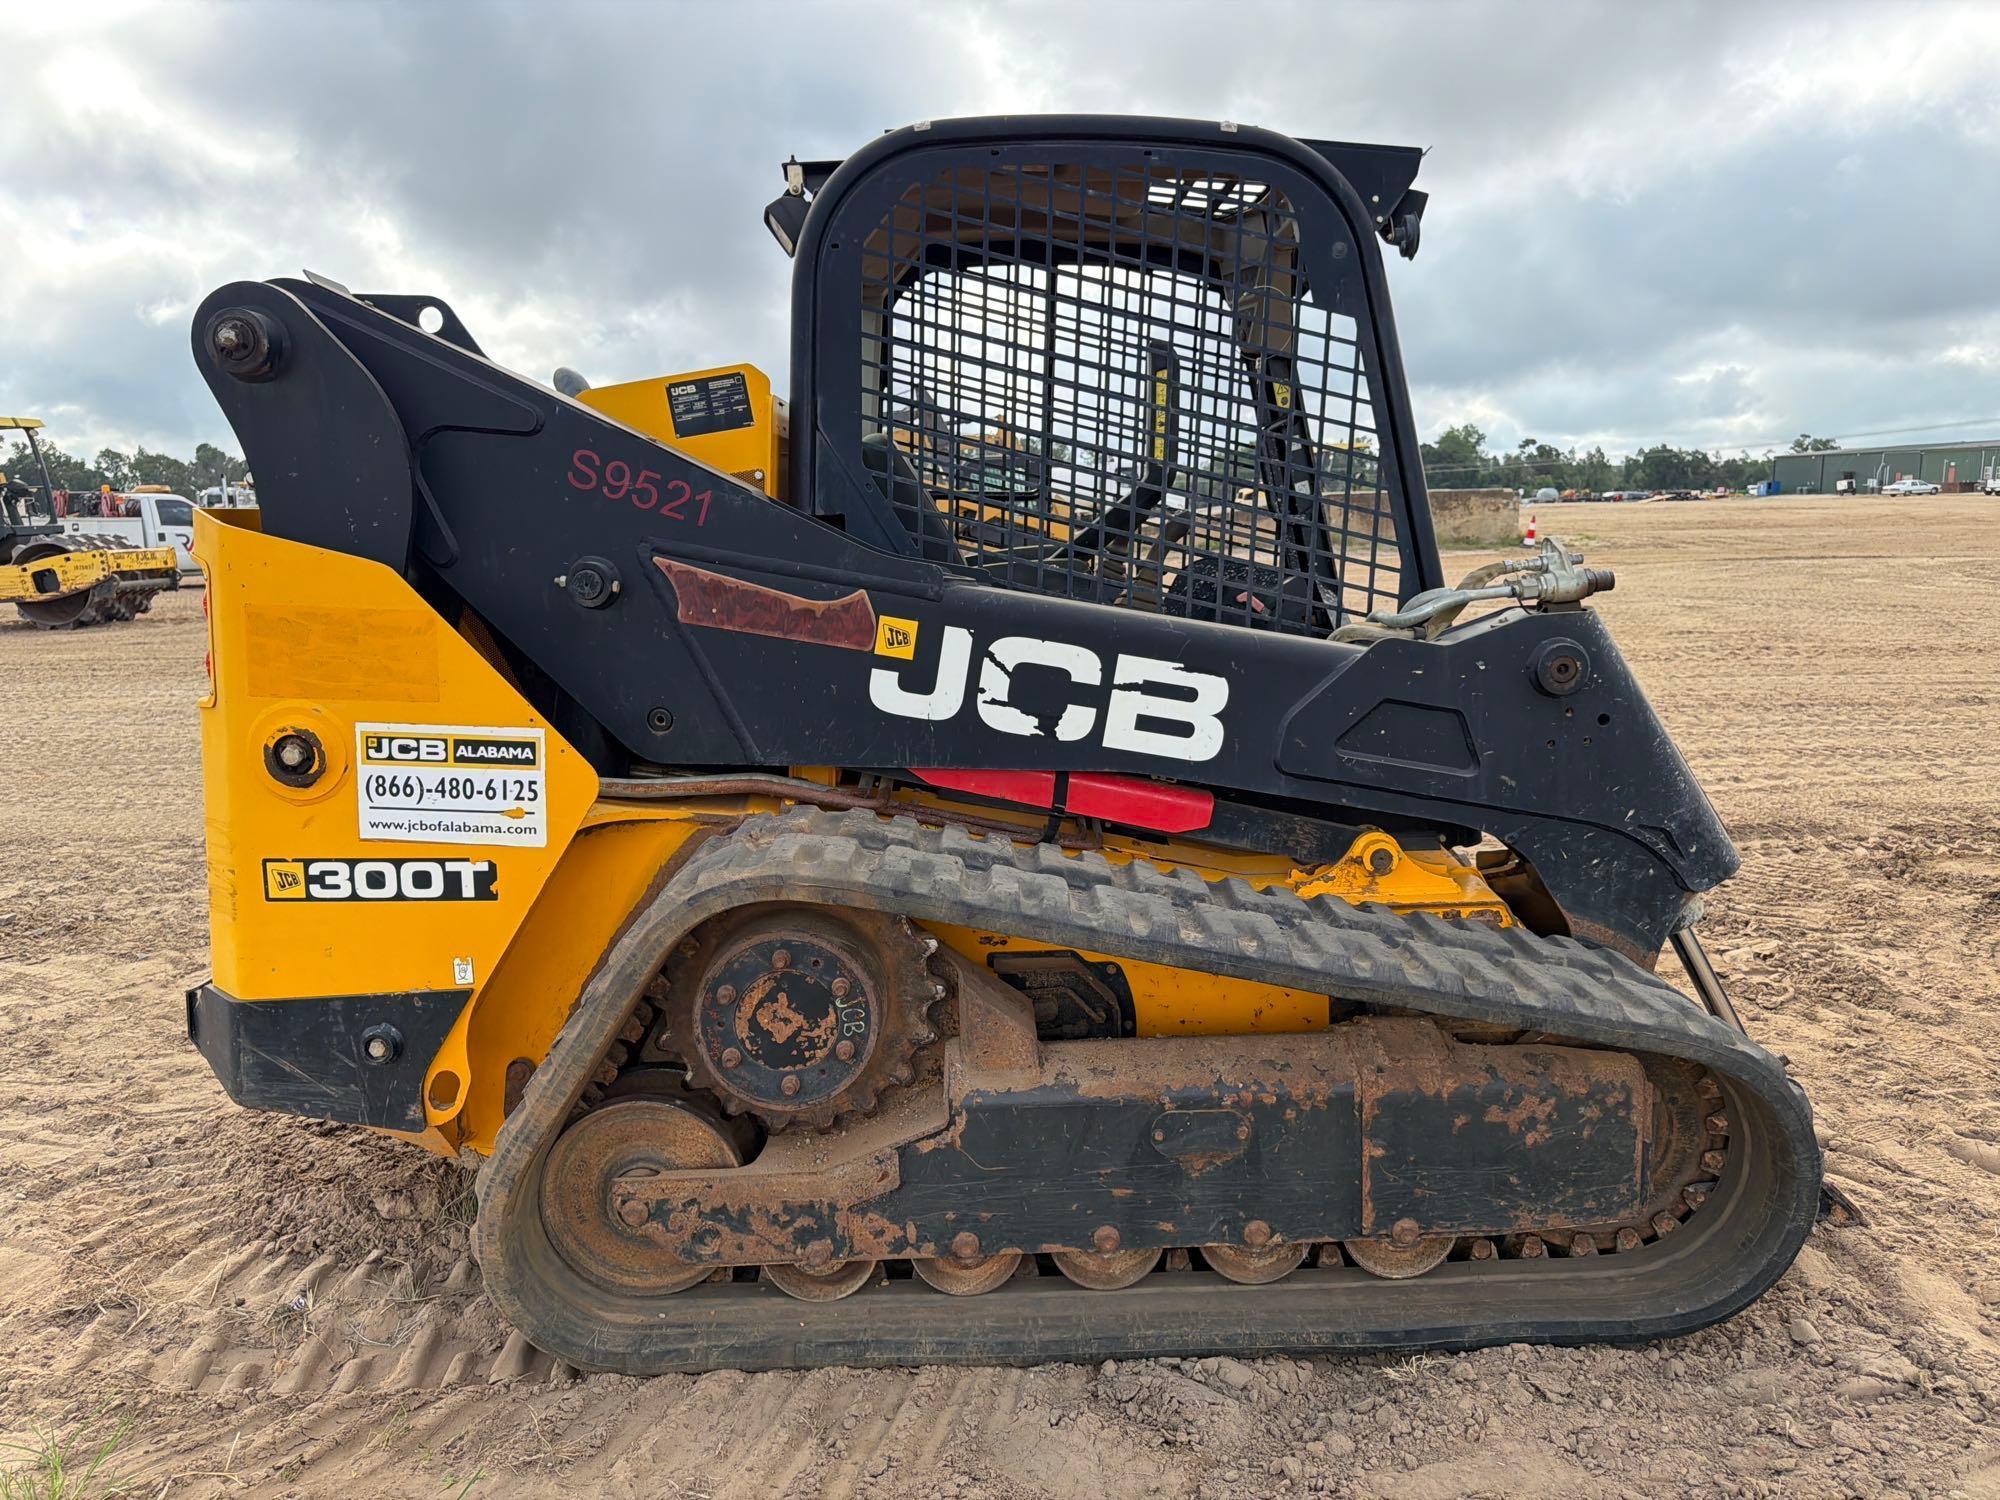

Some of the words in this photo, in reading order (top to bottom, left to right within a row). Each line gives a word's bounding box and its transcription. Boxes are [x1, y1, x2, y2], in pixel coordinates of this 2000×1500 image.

[671, 384, 697, 396] JCB
[567, 449, 713, 527] S9521
[886, 626, 909, 647] JCB
[869, 625, 1229, 762] JCB
[367, 737, 447, 762] JCB
[455, 745, 534, 760] ALABAMA
[365, 774, 539, 805] (866)-480-6125
[368, 819, 538, 836] www.jcbofalabama.com
[277, 871, 300, 890] JCB
[307, 861, 490, 899] 300T
[835, 996, 866, 1037] JCB
